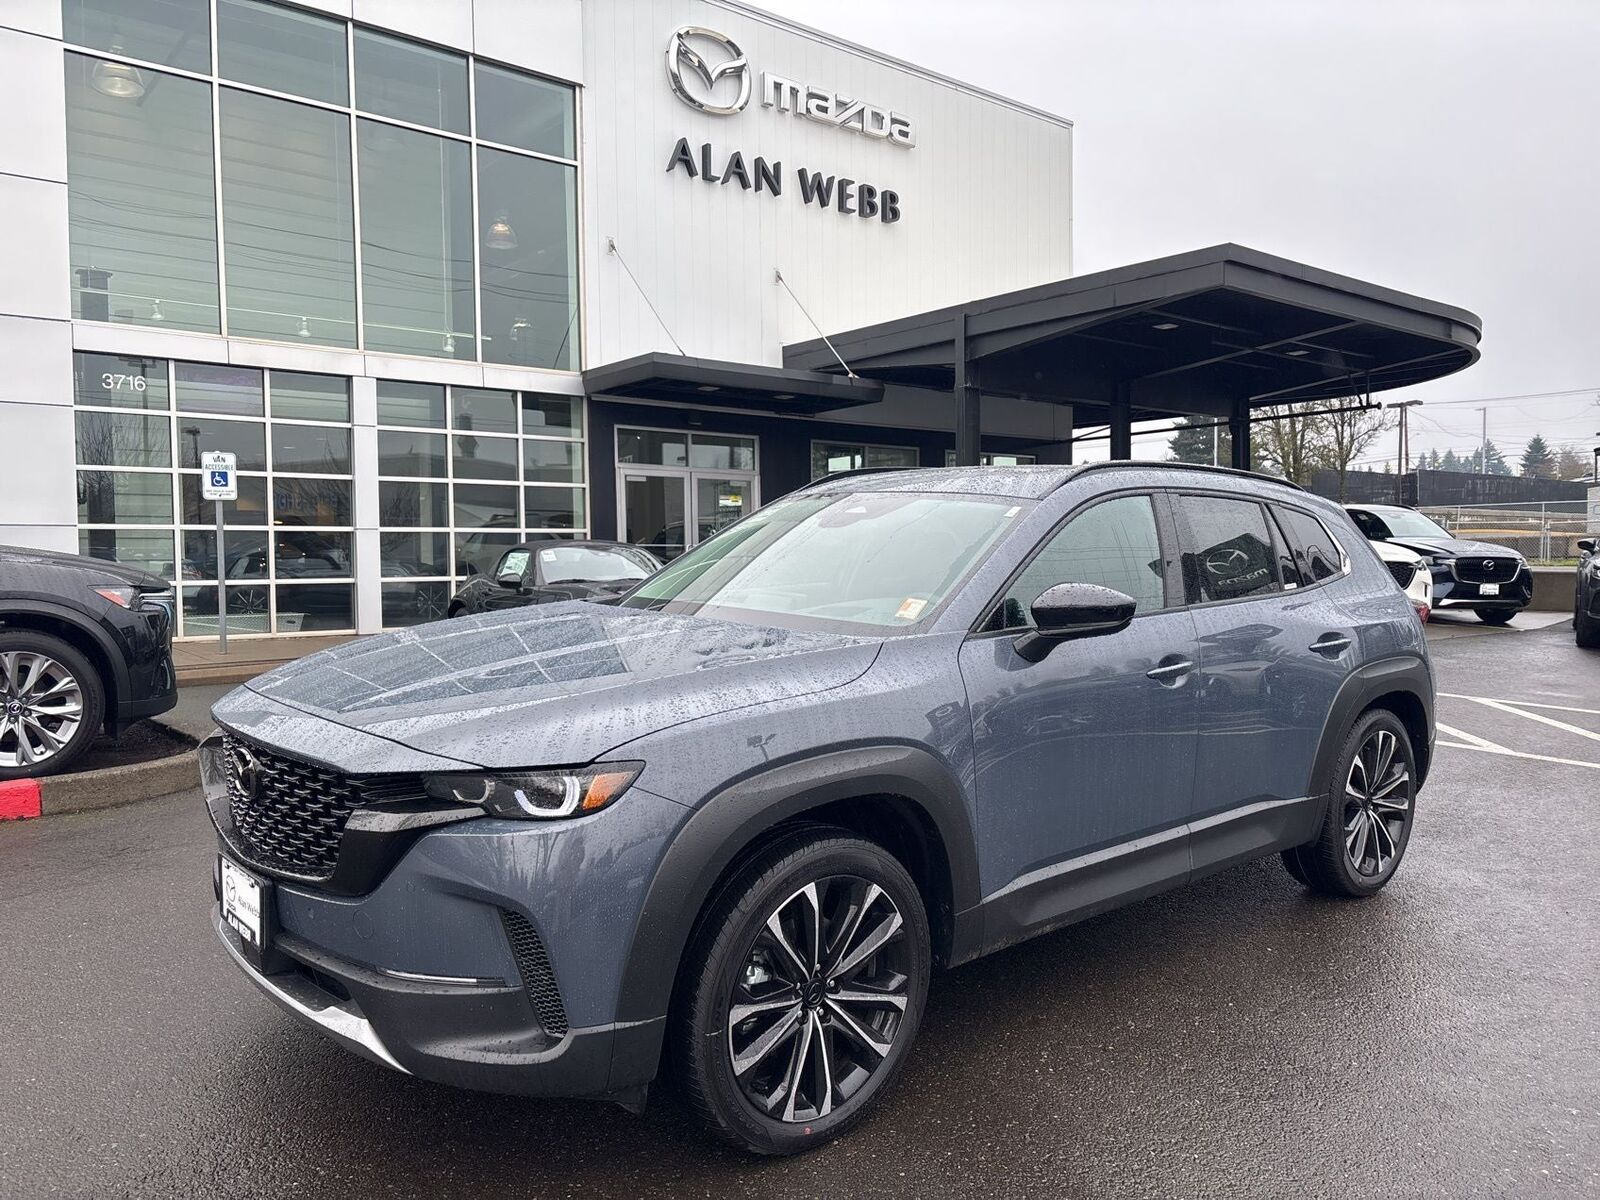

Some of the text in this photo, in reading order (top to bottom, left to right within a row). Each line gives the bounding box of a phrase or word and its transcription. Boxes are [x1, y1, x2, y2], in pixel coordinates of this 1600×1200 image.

[666, 137, 901, 223] ALAN WEBB
[101, 373, 146, 391] 3716
[204, 463, 234, 471] ACCESSIBLE
